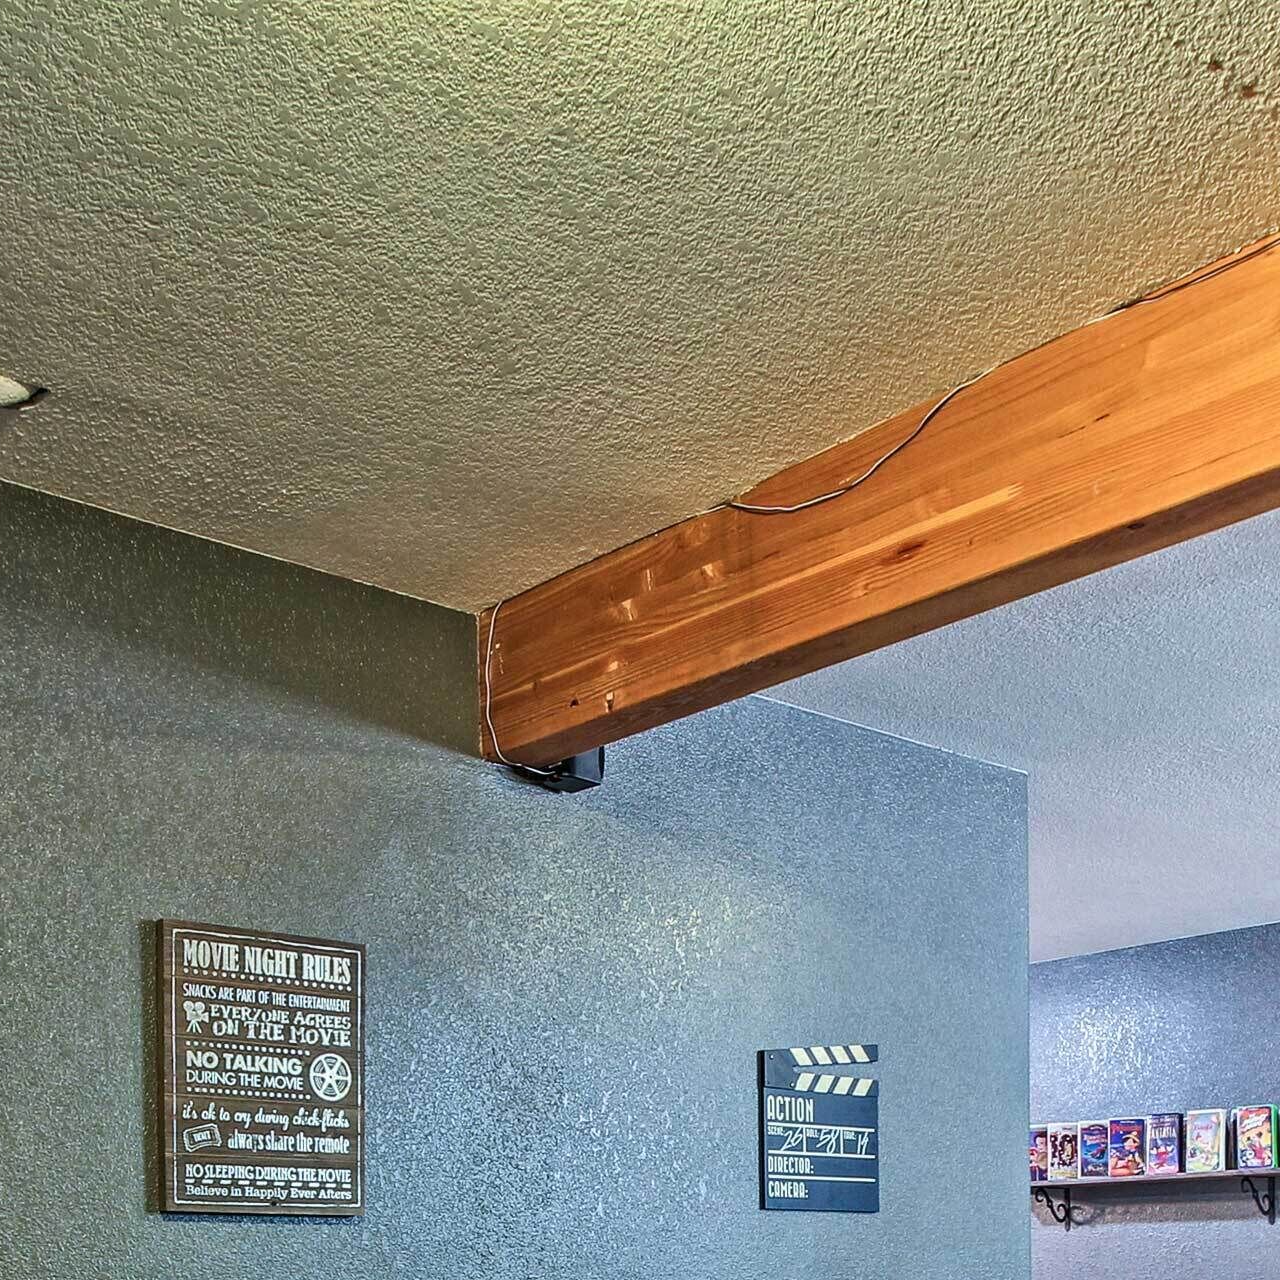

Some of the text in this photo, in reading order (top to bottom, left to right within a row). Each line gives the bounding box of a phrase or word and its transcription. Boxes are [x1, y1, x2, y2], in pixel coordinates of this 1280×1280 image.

[182, 938, 352, 985] MOVIE NIGHT RULES
[183, 982, 217, 999] SNACKS
[218, 986, 234, 1001] ARE
[236, 988, 257, 1004] PART
[258, 991, 270, 1005] OF
[271, 991, 287, 1006] THE
[209, 1003, 352, 1030] EVERYONE AGREES
[212, 1019, 352, 1047] ON THE MOVIE
[185, 1050, 303, 1076] NO TALKING
[186, 1069, 304, 1091] DURING THE MOVIE
[201, 1102, 217, 1121] ok
[219, 1106, 231, 1121] to
[254, 1107, 290, 1131] during
[767, 1094, 814, 1122] ACTION
[227, 1129, 350, 1154] always share the remote
[780, 1126, 803, 1151] 26
[816, 1128, 839, 1154] 58
[185, 1163, 352, 1183] NO SLEEPING DURING THE MOVIE
[767, 1155, 815, 1174] DIRECTOR:
[185, 1185, 352, 1200] Believe in Happily Ever Afters
[768, 1180, 809, 1198] CAMERA:
